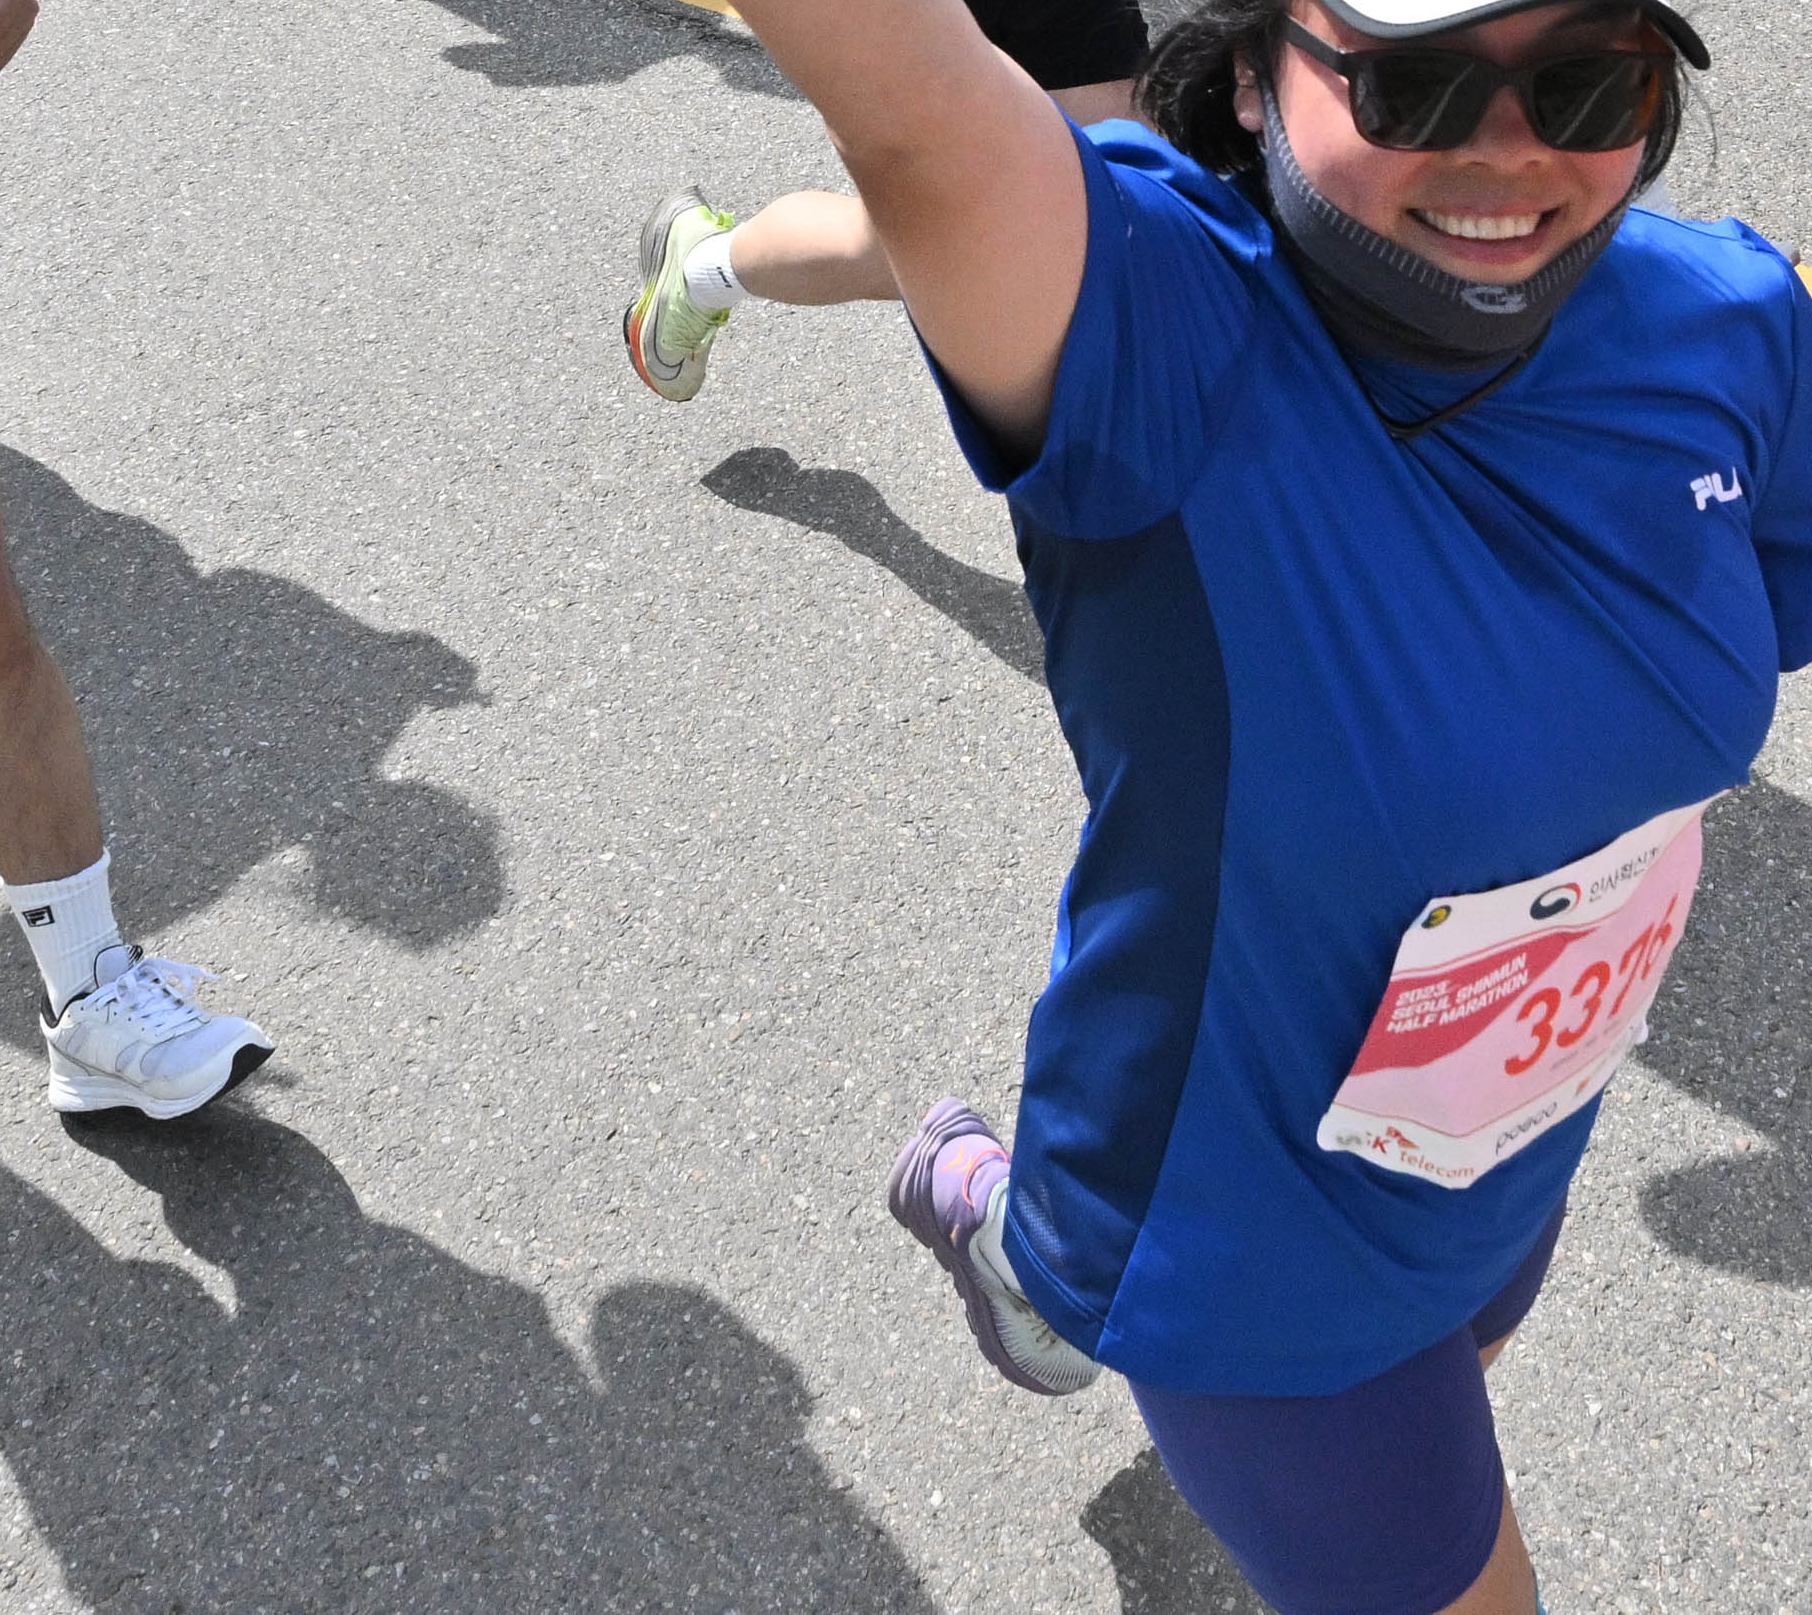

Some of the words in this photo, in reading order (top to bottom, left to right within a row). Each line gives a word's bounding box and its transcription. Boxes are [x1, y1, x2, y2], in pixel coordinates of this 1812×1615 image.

[1387, 1012, 1438, 1034] HALF
[1438, 968, 1529, 1027] MARATHON
[1391, 994, 1451, 1021] SEOUL
[1455, 951, 1527, 1005] SHINMUN
[1504, 892, 1679, 1077] 3376
[1495, 1101, 1558, 1154] posco
[1399, 1150, 1476, 1179] telecom
